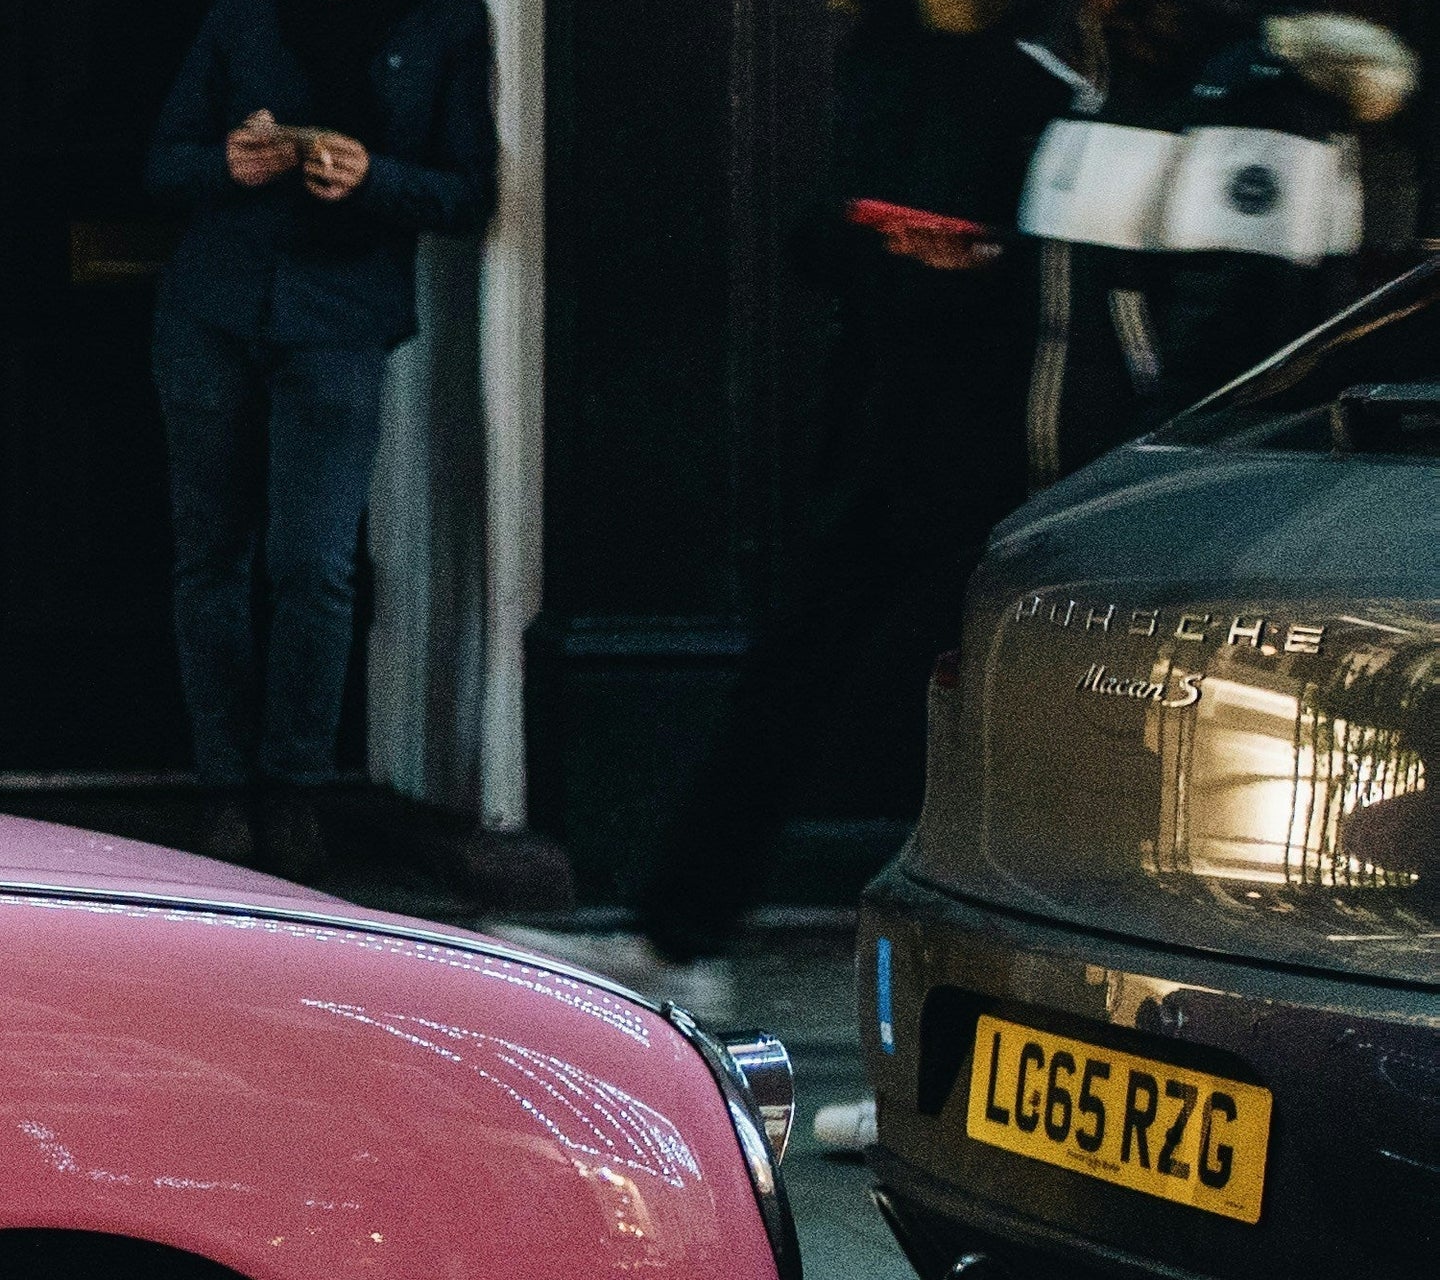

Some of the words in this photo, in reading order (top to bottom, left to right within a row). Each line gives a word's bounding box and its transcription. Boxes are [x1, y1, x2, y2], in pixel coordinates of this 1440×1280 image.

[1076, 663, 1163, 701] Macan
[1162, 672, 1204, 707] S
[985, 1031, 1111, 1153] LC65
[1120, 1069, 1238, 1190] RZG
